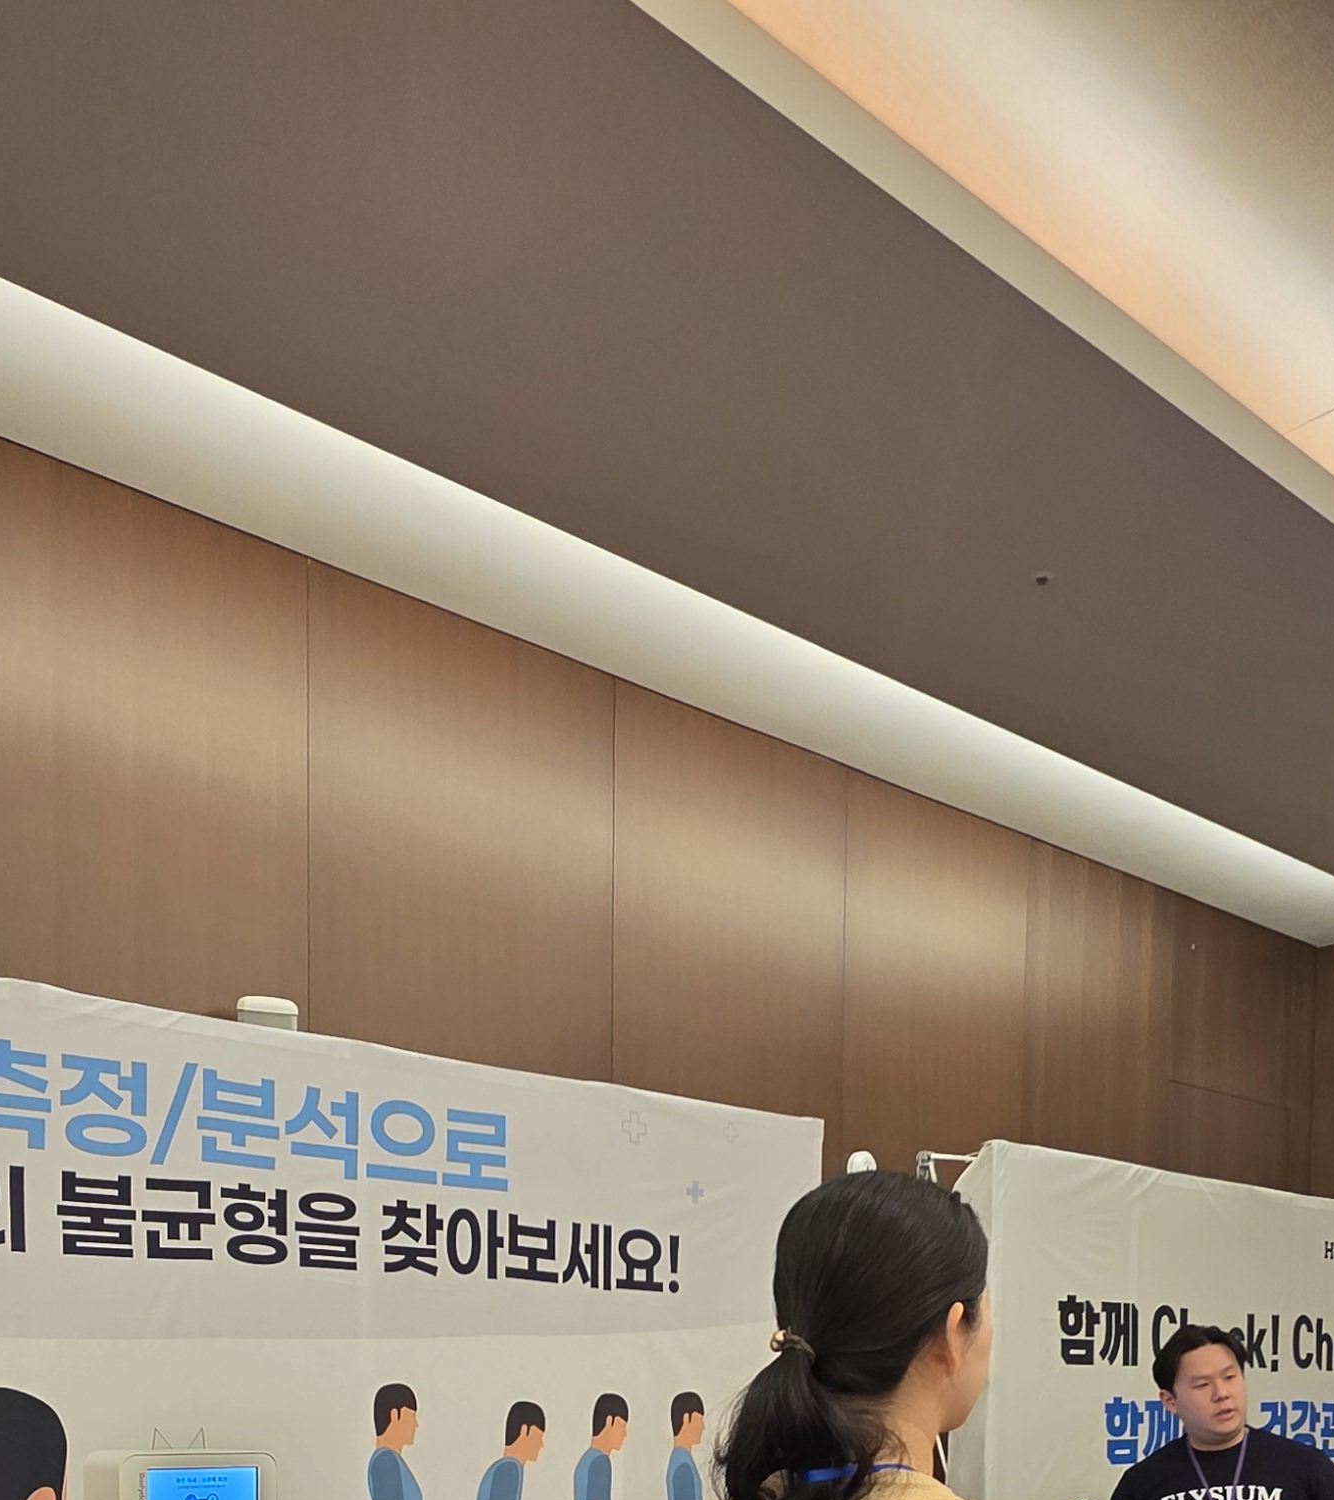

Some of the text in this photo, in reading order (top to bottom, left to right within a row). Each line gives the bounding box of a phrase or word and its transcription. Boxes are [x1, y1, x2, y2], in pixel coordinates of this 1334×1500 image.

[56, 1170, 360, 1272] 불균형을
[382, 1198, 681, 1294] 찾아보세요!
[1058, 1294, 1139, 1367] 함께
